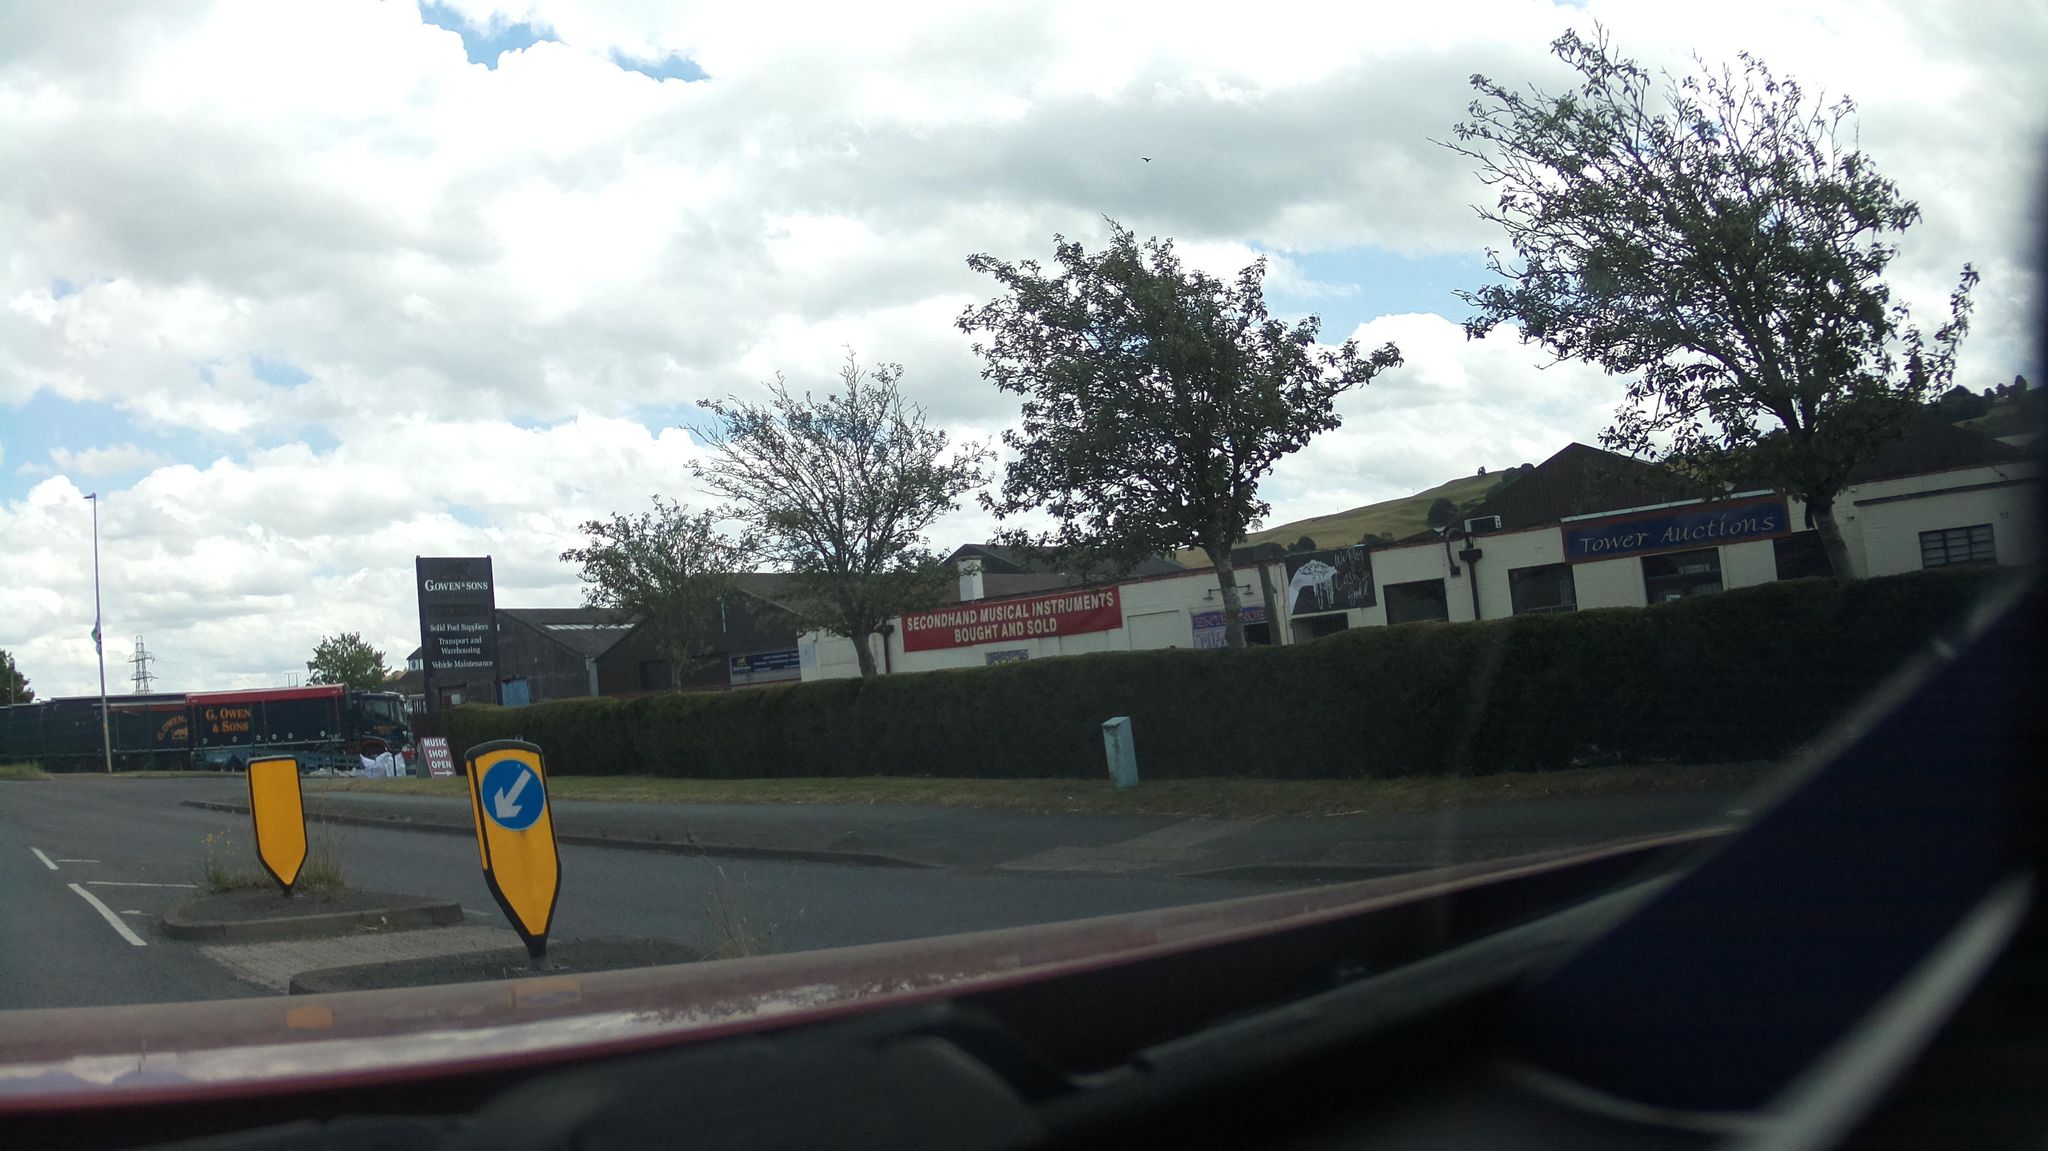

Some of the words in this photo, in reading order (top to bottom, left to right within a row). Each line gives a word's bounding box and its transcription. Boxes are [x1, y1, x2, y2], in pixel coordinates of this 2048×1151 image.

[1578, 531, 1649, 554] Tower
[1660, 512, 1776, 544] Auctions
[466, 581, 489, 591] SONS
[907, 610, 977, 632] SECONDHAND
[980, 604, 1029, 622] MUSICAL
[1031, 591, 1115, 616] INSTRUMENTS
[430, 623, 445, 632] Solid
[446, 623, 460, 632] Fuel
[460, 622, 489, 632] Suppliers
[954, 625, 998, 643] BOUGHT
[1001, 622, 1024, 637] AND
[1027, 617, 1057, 636] SOLD
[438, 637, 469, 647] Transport
[470, 635, 482, 644] and
[441, 645, 481, 655] Warehousing
[431, 660, 453, 669] Vehicle
[454, 659, 494, 668] Maintenance
[220, 707, 252, 719] OWEN
[222, 720, 249, 732] SONS
[423, 738, 447, 747] MUSIC
[428, 749, 448, 758] SHOP
[431, 760, 452, 769] OPEN
